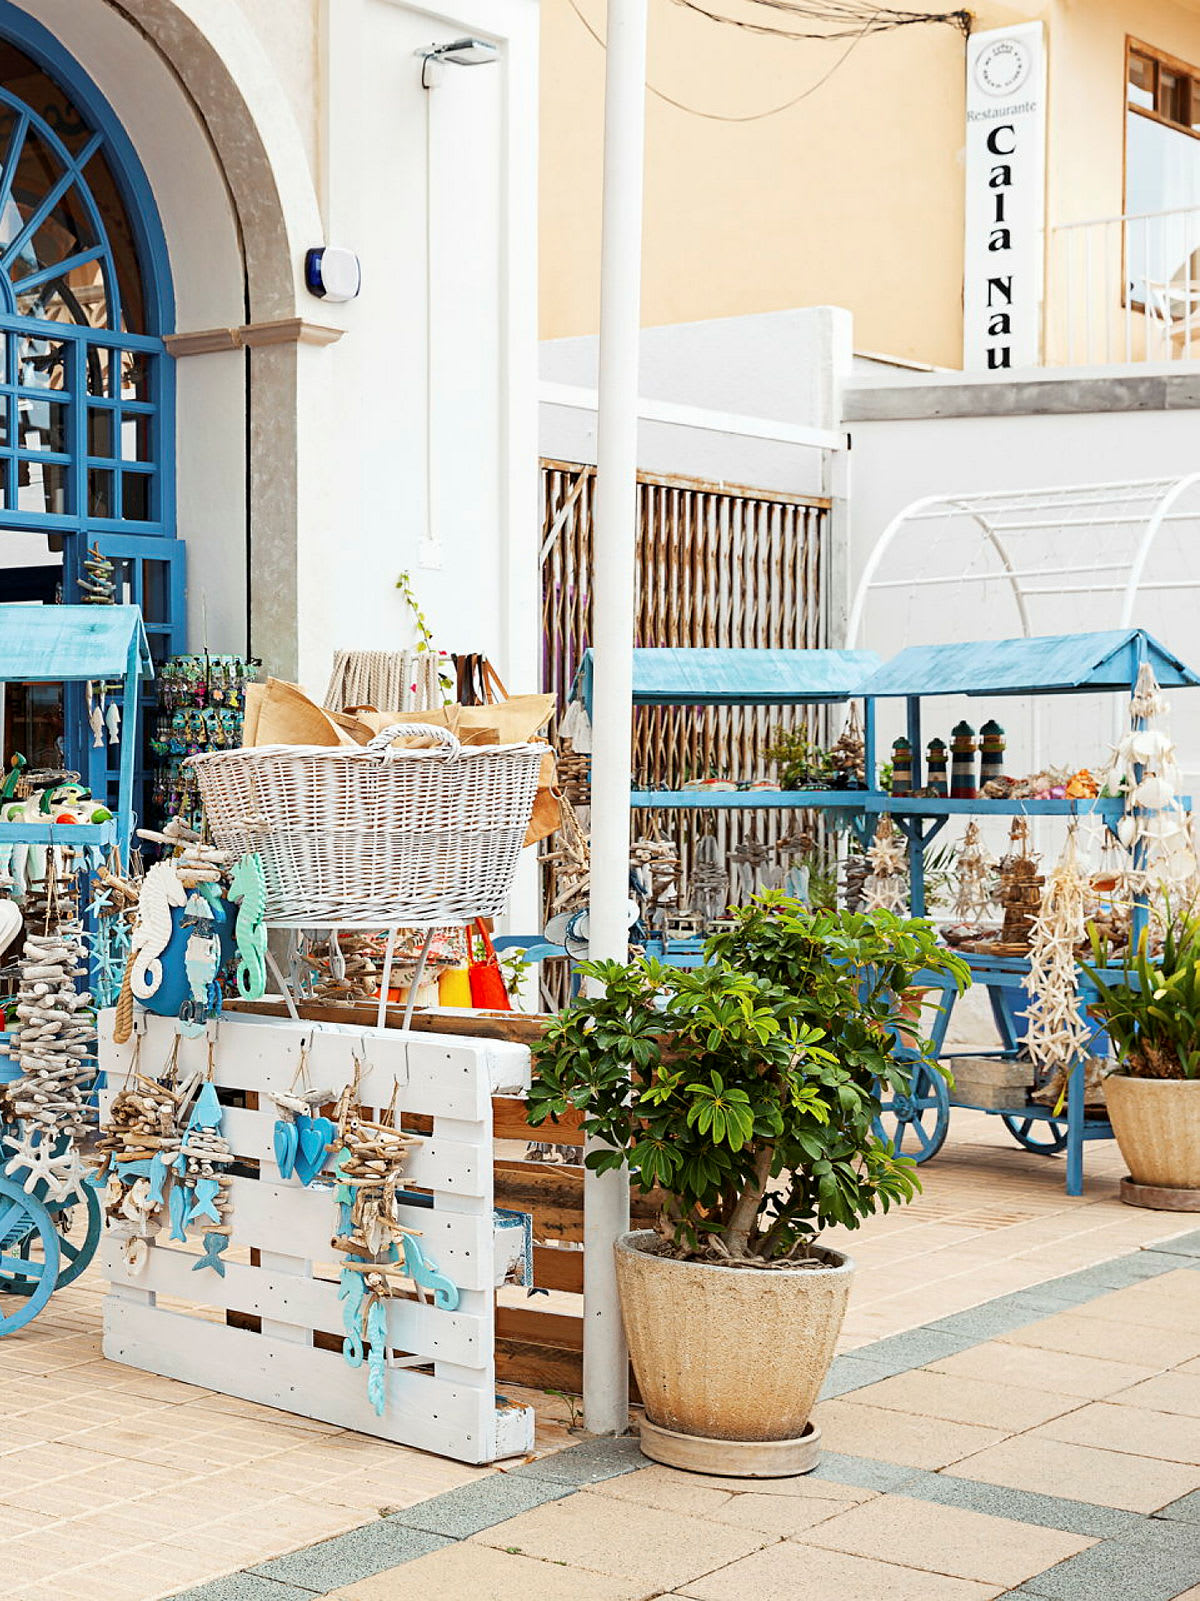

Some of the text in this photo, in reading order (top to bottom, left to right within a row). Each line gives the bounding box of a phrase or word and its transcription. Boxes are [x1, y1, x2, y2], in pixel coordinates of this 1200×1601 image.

[966, 101, 1038, 122] Restaurante
[986, 124, 1017, 370] Cala Nau
